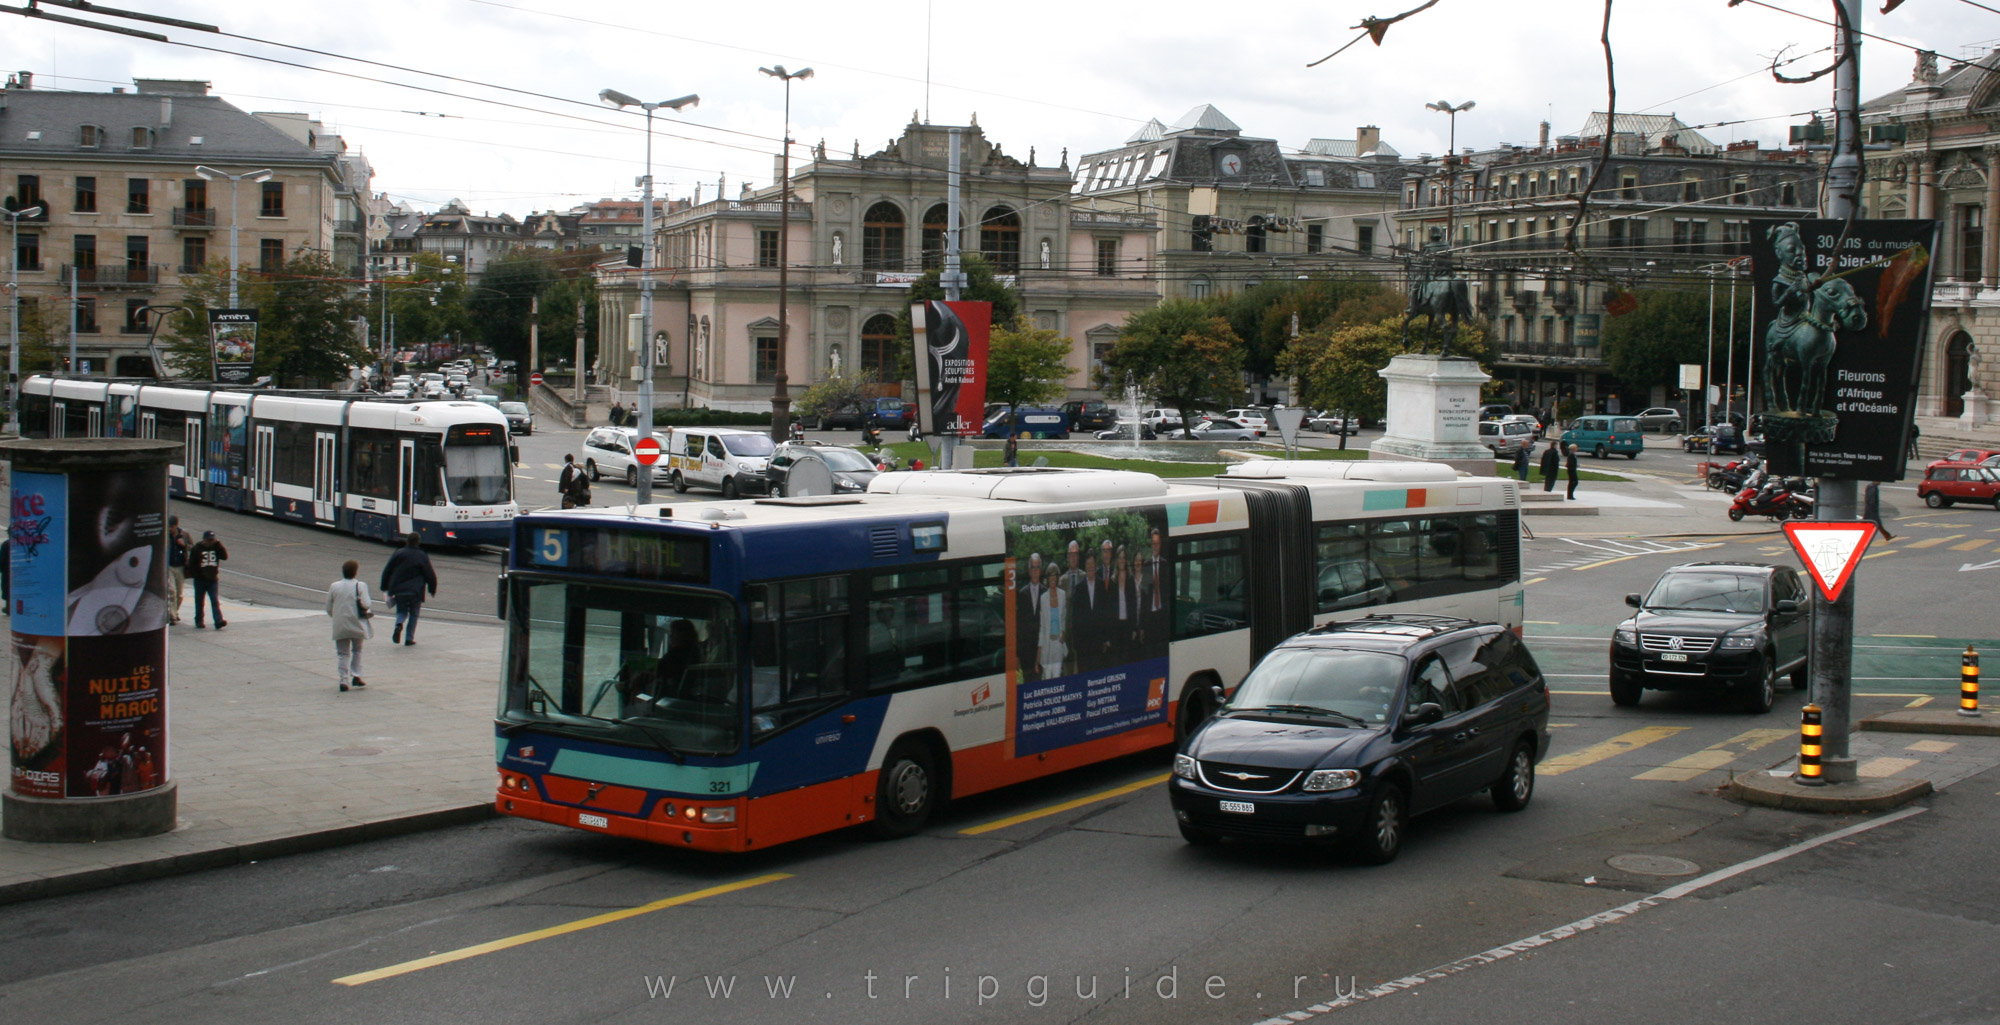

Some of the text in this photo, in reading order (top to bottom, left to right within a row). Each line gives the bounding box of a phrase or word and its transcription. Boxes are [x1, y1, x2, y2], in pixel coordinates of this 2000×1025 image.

[1817, 235, 1834, 249] 30
[1868, 240, 1882, 249] du
[944, 367, 975, 375] SCULPTURES
[1838, 369, 1885, 382] Fleurons
[1837, 387, 1882, 400] d'Afrique
[1836, 402, 1898, 413] et d'Océanie
[946, 415, 972, 430] adler
[1078, 519, 1097, 528] octobre
[542, 529, 562, 562] 5
[1008, 569, 1017, 590] 3
[133, 665, 151, 675] LES
[89, 674, 151, 695] NUITS
[1087, 676, 1107, 687] Bernard
[1023, 684, 1066, 700] Luc BARTHASSAT
[101, 694, 117, 704] DU
[101, 697, 159, 719] MAROC
[710, 781, 732, 793] 321
[1230, 803, 1241, 811] 555
